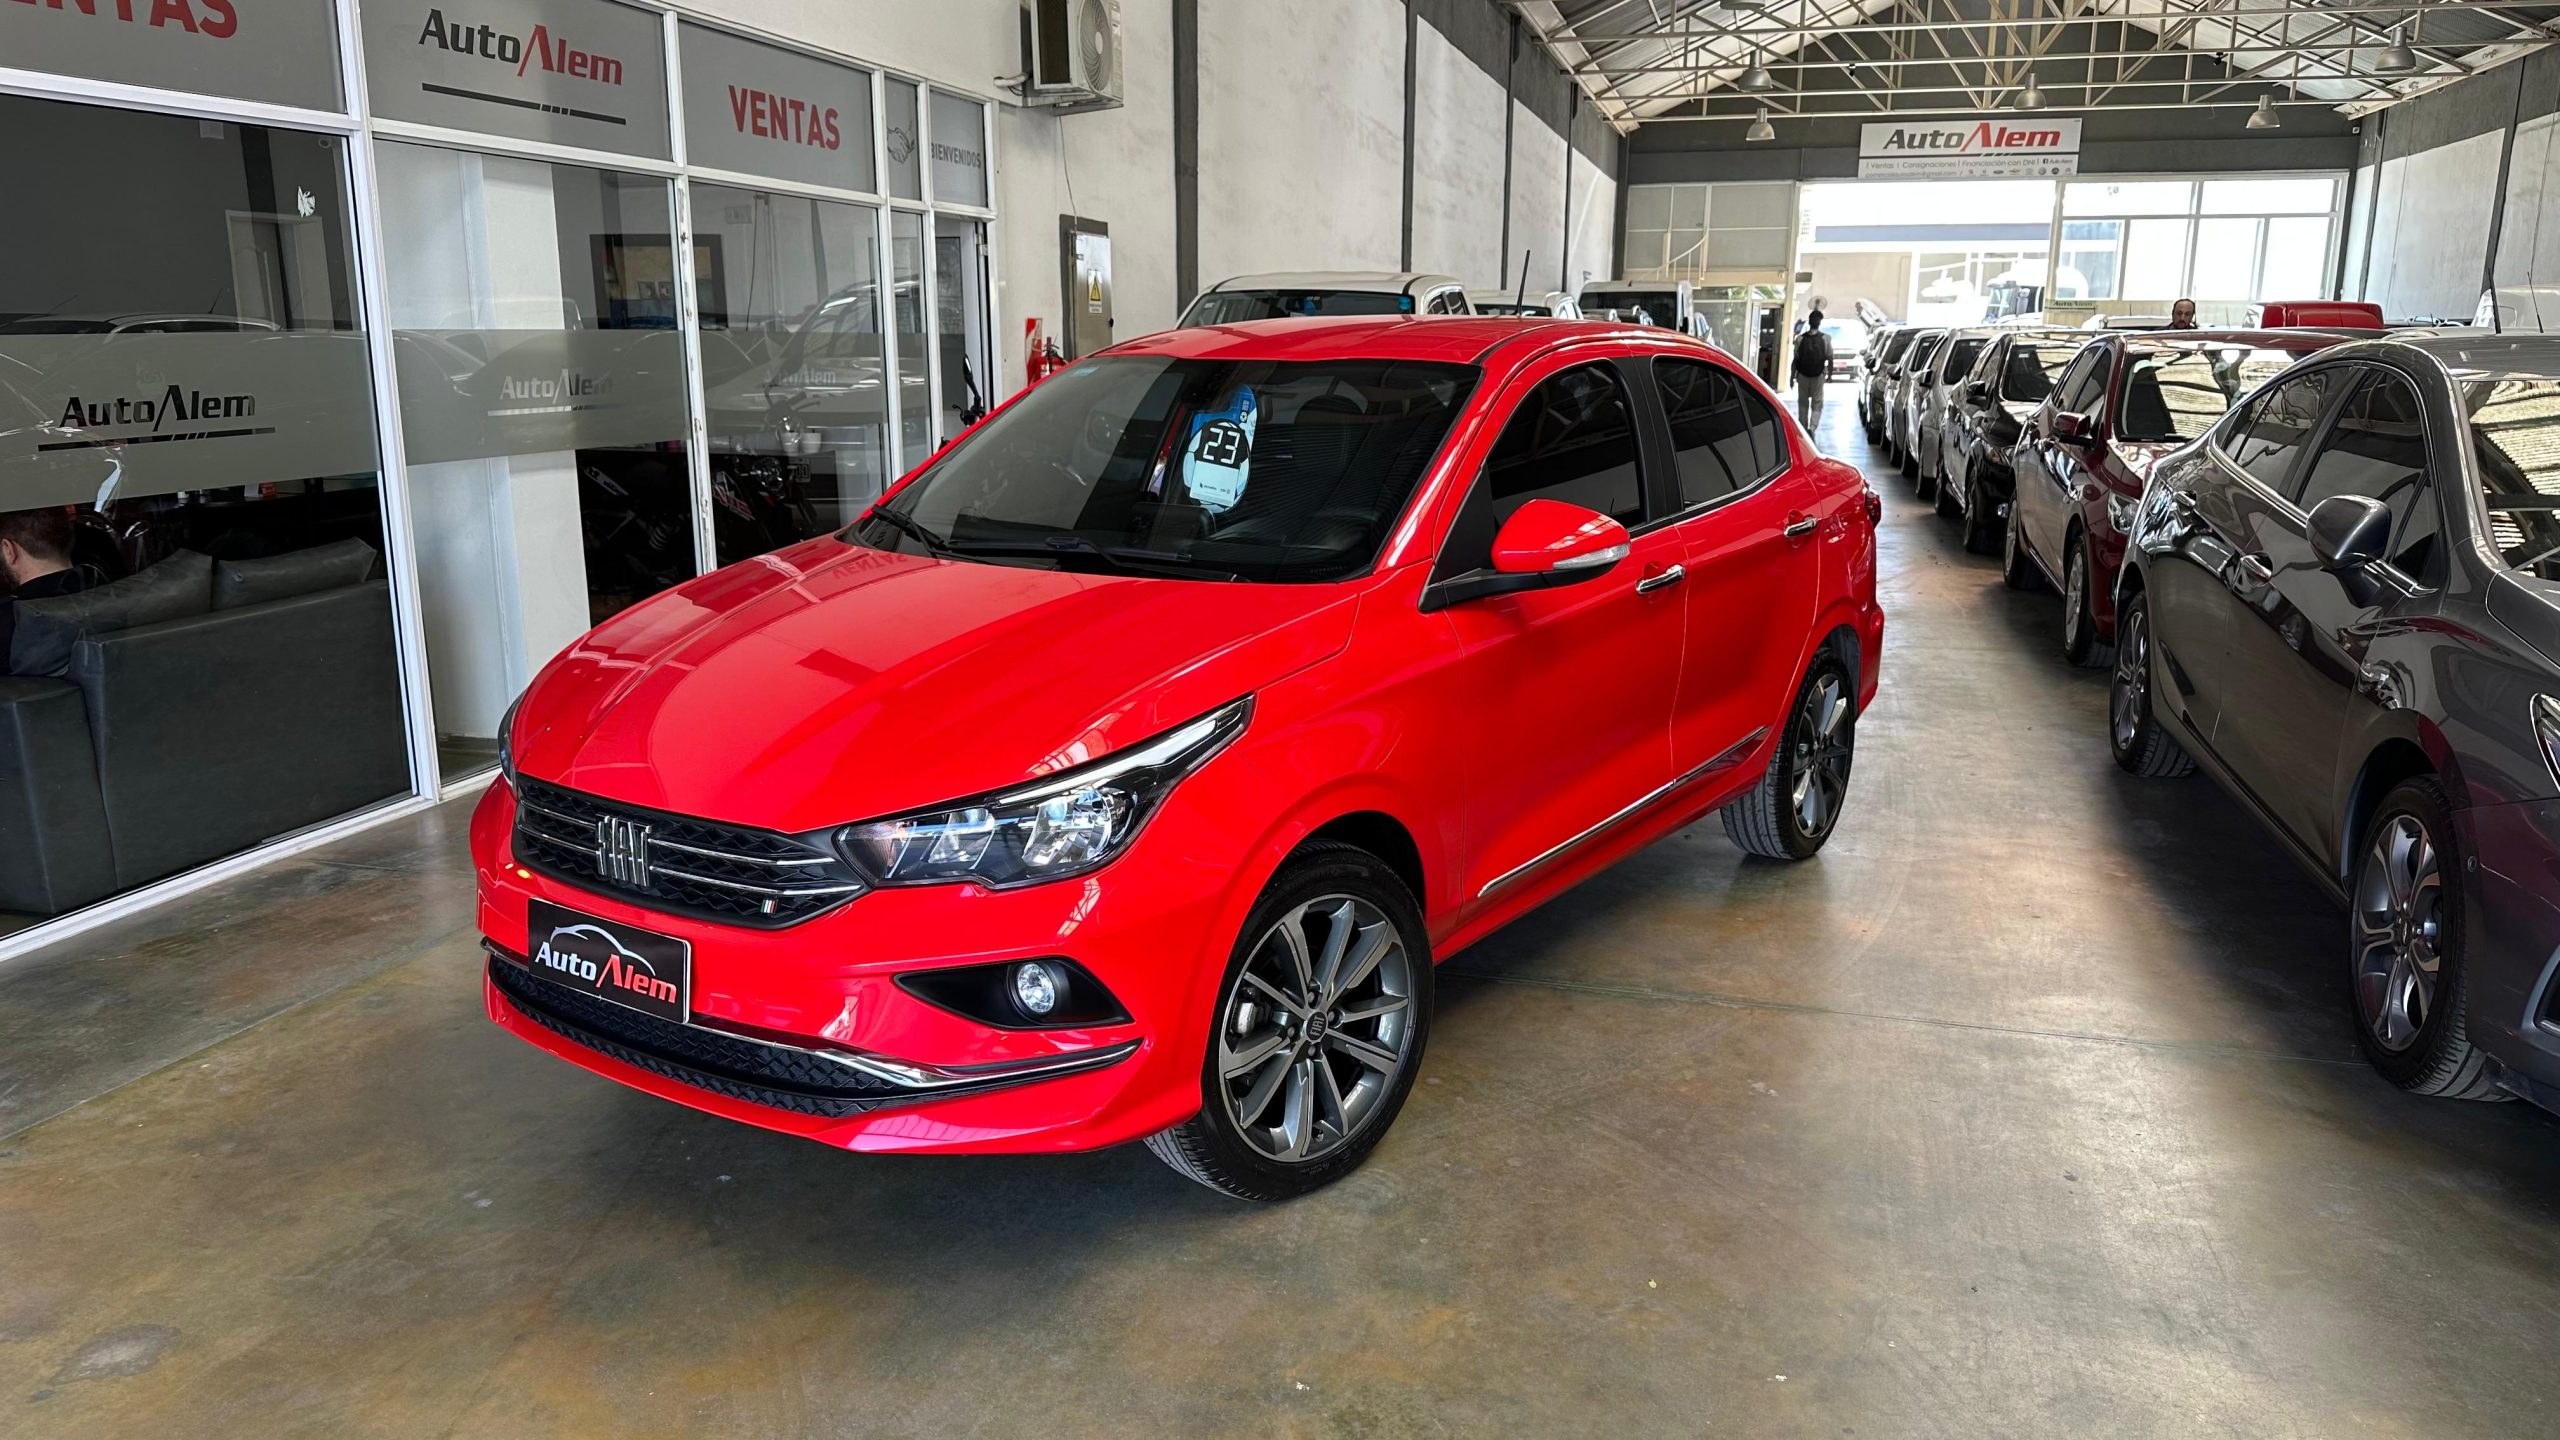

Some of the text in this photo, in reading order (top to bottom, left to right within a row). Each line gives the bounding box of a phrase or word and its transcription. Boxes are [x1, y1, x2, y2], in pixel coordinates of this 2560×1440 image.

[418, 8, 622, 85] AutoAlem
[728, 84, 840, 151] VENTAS
[1883, 121, 2061, 152] AutoAlem
[1902, 161, 1956, 169] Consignaciones
[59, 384, 256, 433] AutoAlem
[1202, 427, 1241, 465] 23
[596, 814, 652, 888] FIAT
[1309, 1014, 1325, 1037] FIAT
